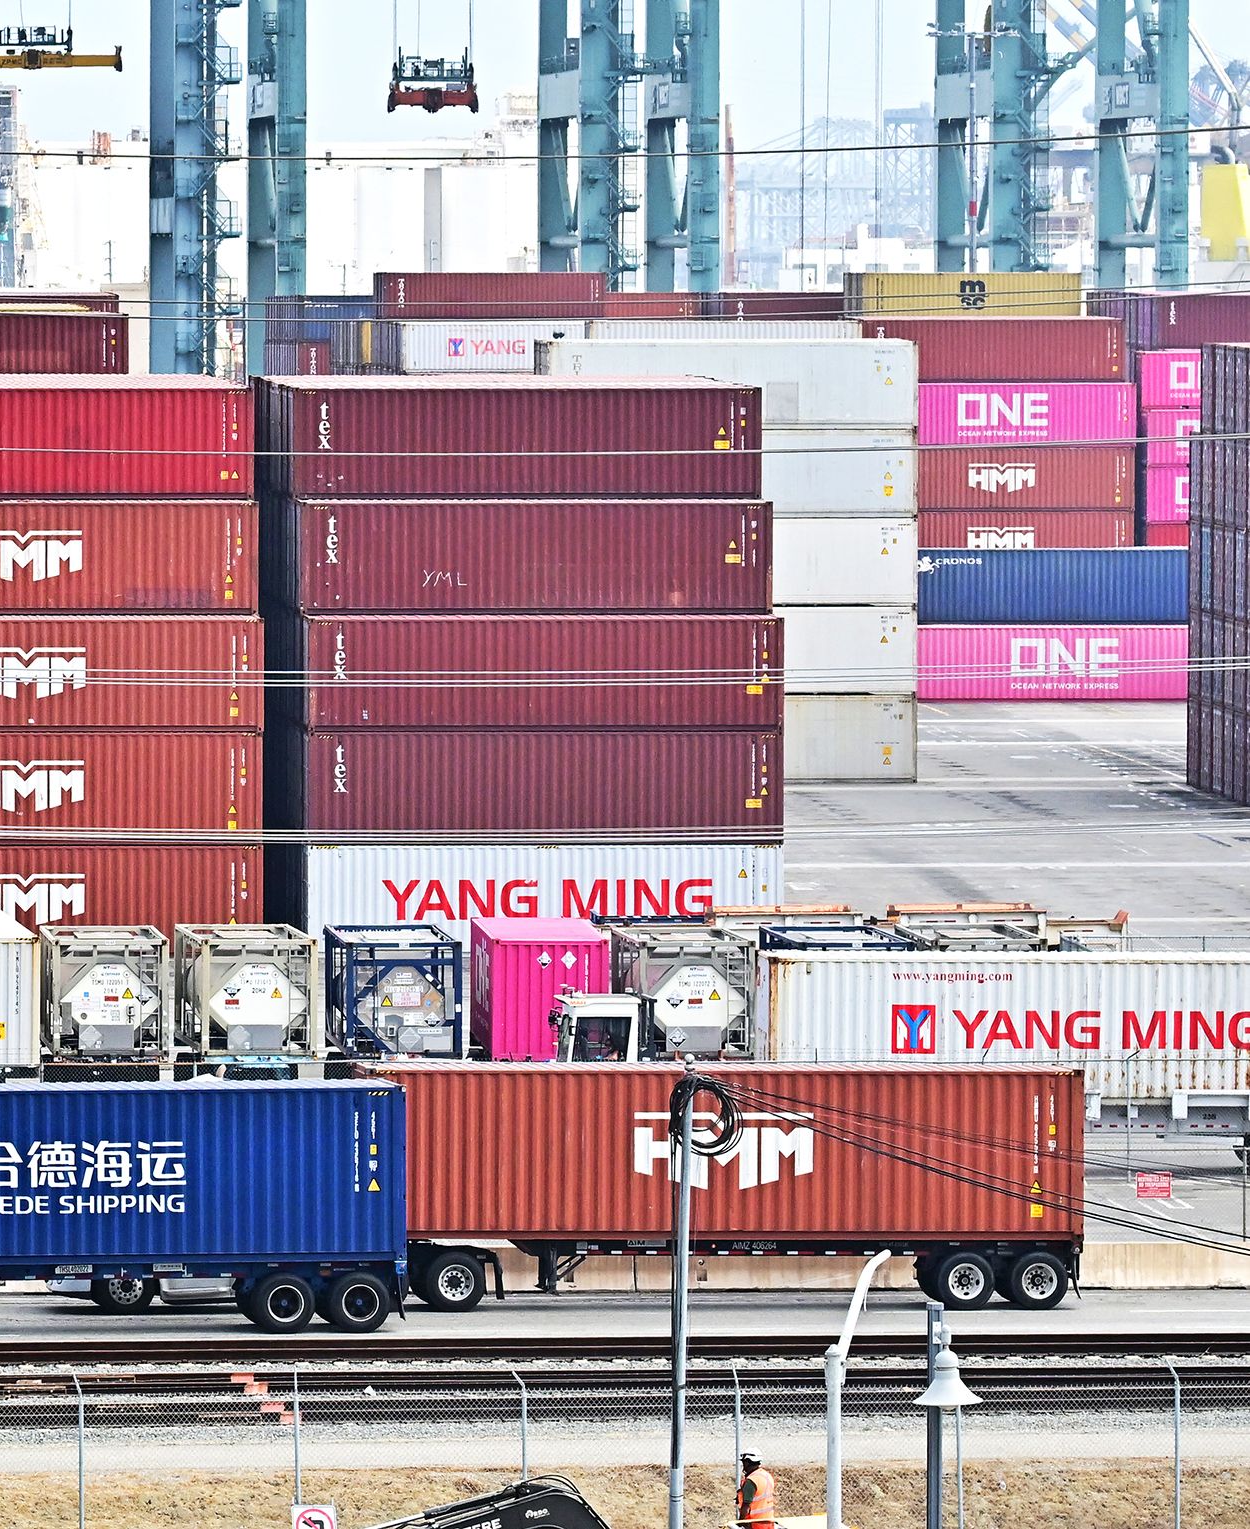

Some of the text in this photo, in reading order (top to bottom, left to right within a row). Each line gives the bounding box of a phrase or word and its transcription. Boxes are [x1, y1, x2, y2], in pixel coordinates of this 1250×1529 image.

[470, 339, 525, 355] YANG
[318, 401, 332, 450] tex
[957, 392, 1049, 427] ONE
[968, 463, 1036, 493] HMM
[326, 515, 341, 564] tex
[936, 556, 983, 565] CRONOS
[422, 569, 468, 588] YML
[333, 632, 348, 680] tex
[1011, 637, 1119, 678] ONE
[1011, 682, 1119, 690] OCEAN NETWORK EXPRESS
[333, 744, 348, 793] tex
[382, 878, 714, 921] YANG MING
[892, 971, 1013, 984] www.yangming.com
[952, 1010, 1101, 1050] YANG
[634, 1112, 814, 1191] HMM
[59, 1193, 186, 1215] SHIPPING
[732, 1241, 777, 1250] AIMZ 406264
